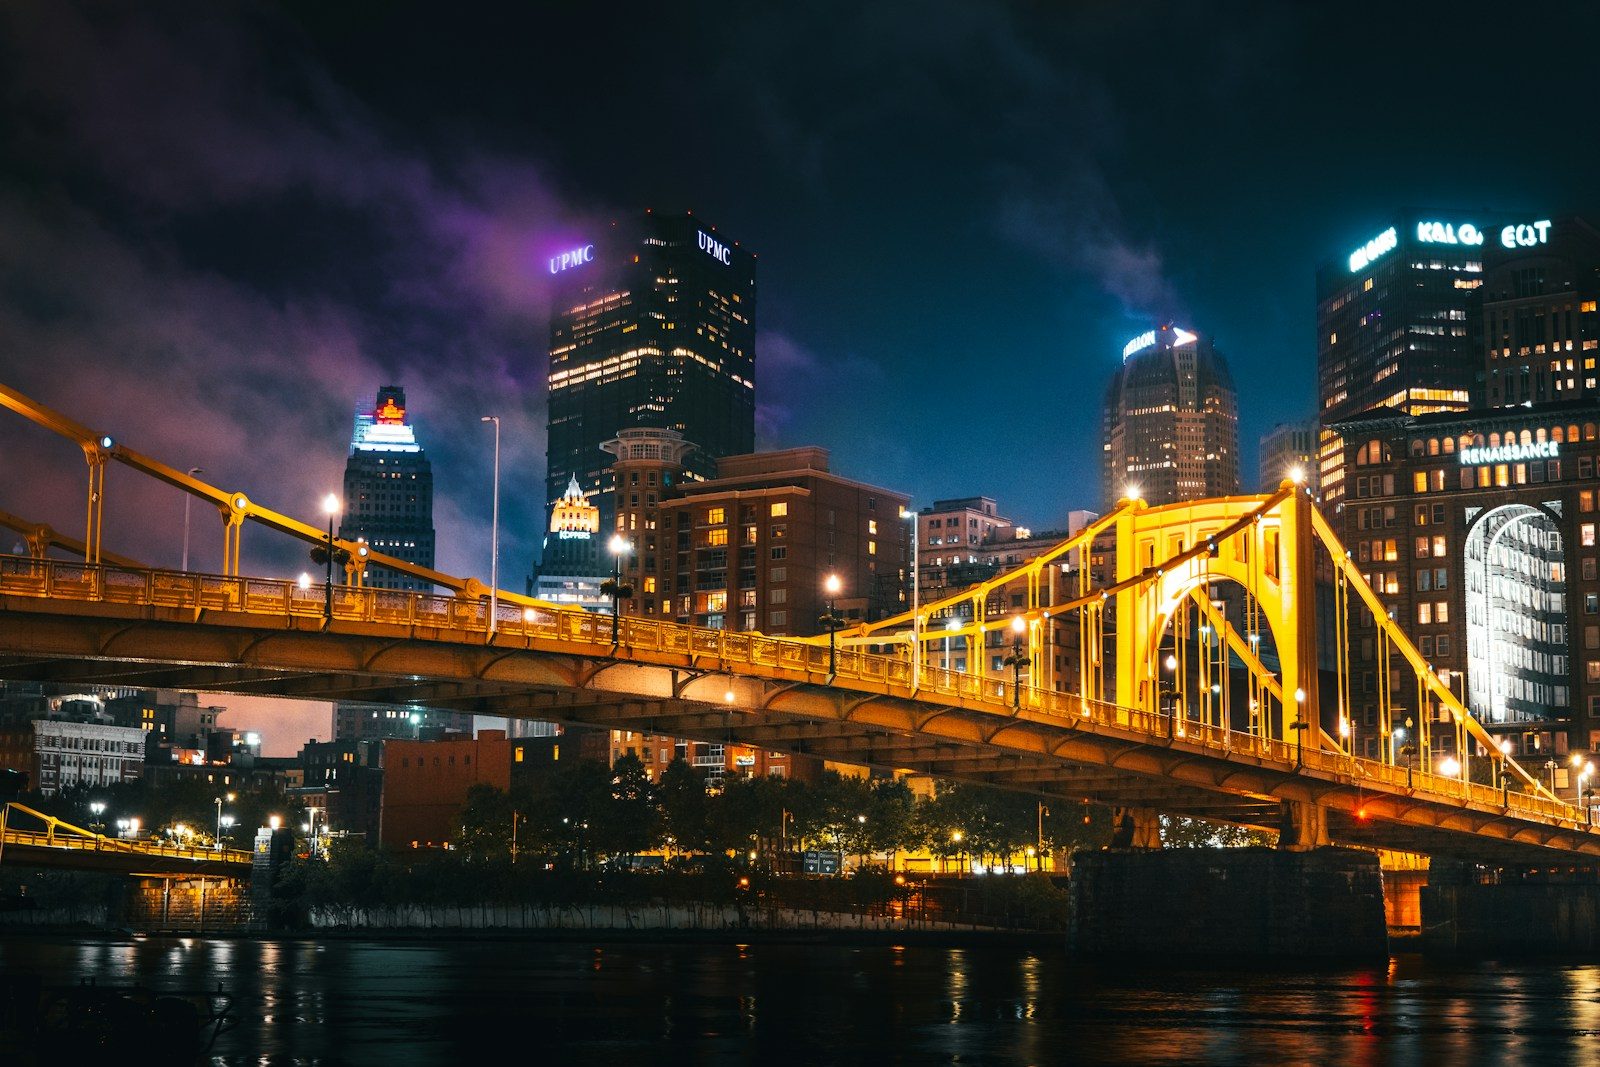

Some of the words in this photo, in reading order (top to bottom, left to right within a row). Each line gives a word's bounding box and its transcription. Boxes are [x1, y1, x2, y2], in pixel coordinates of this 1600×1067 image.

[697, 230, 731, 266] UPMC
[1501, 219, 1552, 248] EQT
[550, 244, 594, 274] UPMC
[1460, 440, 1559, 465] RENAISSANCE
[559, 530, 591, 540] KOPPERS
